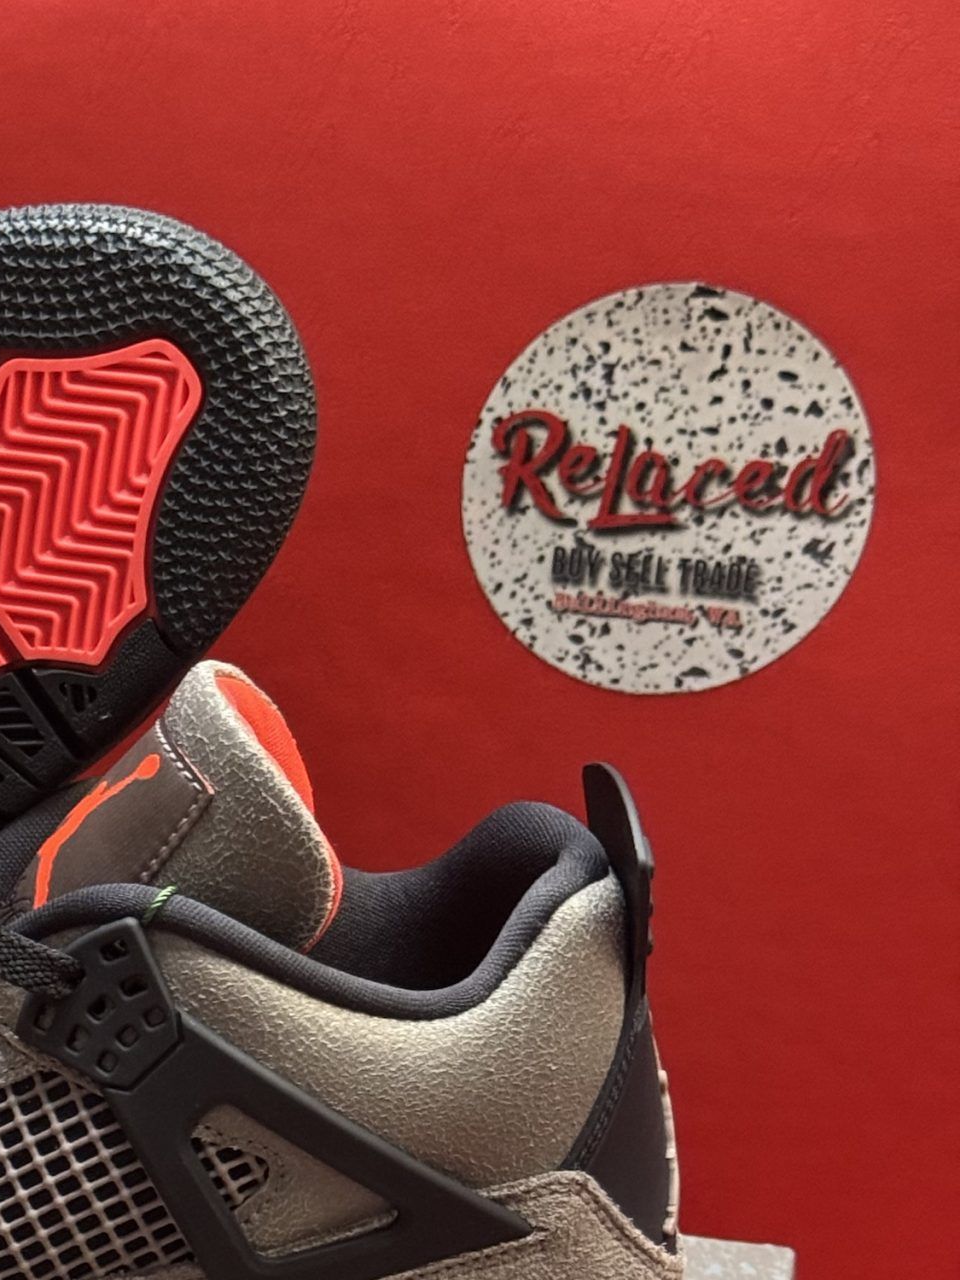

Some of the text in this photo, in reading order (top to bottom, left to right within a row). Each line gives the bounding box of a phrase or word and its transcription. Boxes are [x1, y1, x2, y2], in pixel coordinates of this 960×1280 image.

[492, 410, 850, 530] ReLaced
[552, 546, 761, 602] BUY SELL TRADE
